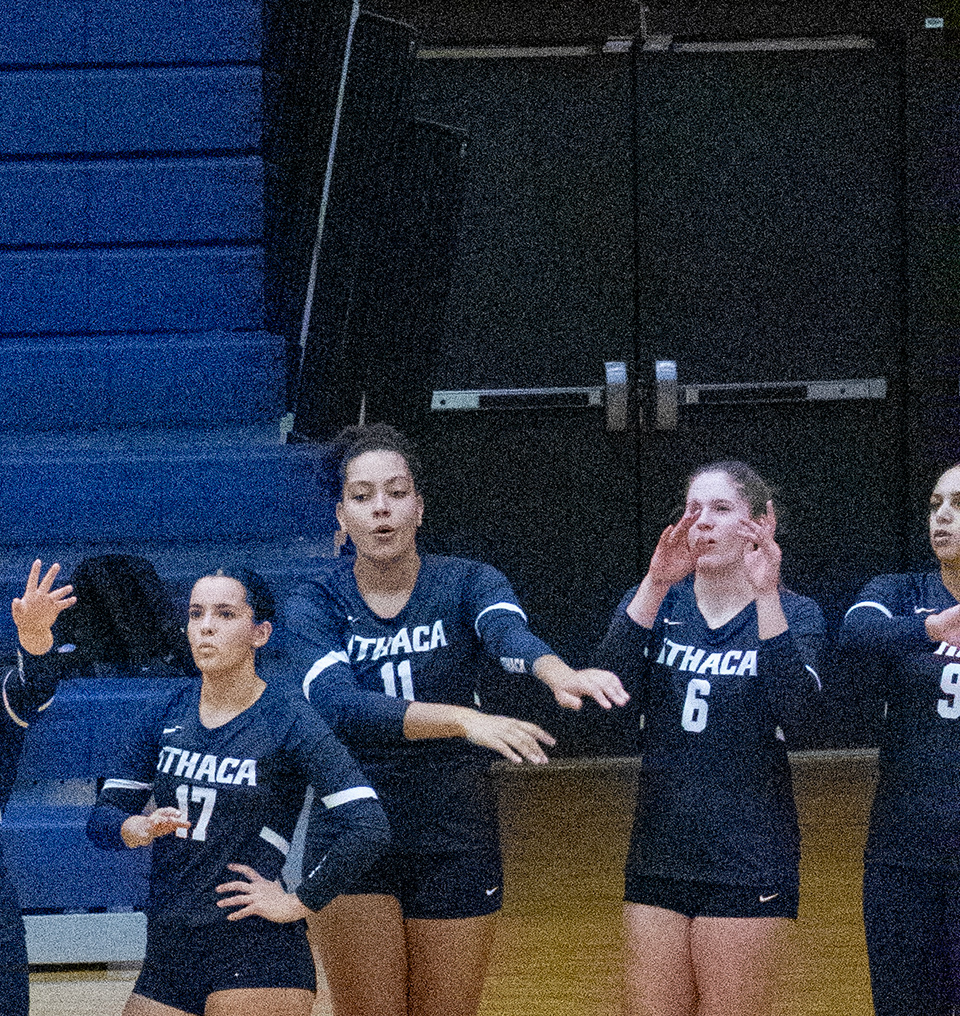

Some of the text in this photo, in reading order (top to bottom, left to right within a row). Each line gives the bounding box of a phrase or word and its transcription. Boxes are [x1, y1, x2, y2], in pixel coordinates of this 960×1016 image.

[347, 620, 447, 662] ITHACA
[656, 638, 758, 676] ITHACA
[380, 659, 415, 701] 11
[681, 678, 711, 733] 6
[156, 746, 257, 786] ITHACA
[175, 785, 217, 841] 17
